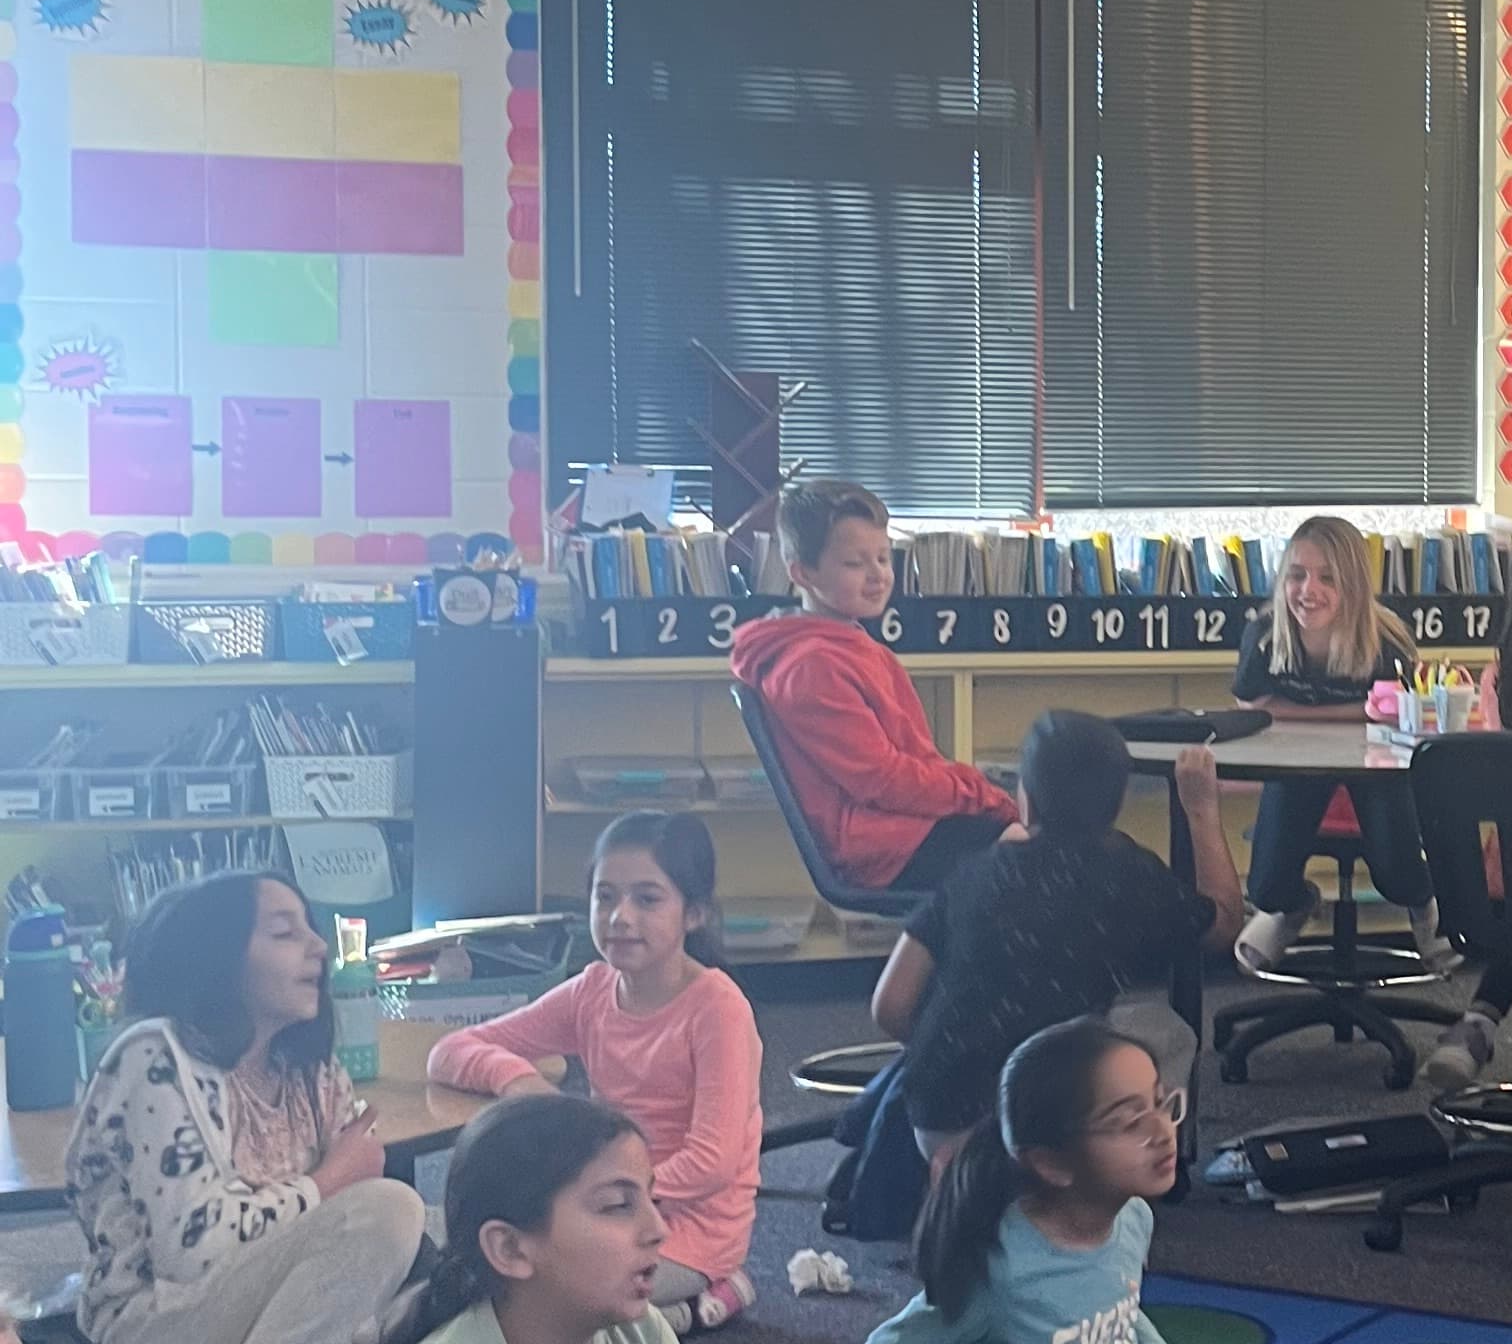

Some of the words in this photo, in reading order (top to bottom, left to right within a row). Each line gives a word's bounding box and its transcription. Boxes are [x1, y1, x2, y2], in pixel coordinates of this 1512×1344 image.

[600, 605, 620, 655] 1
[658, 606, 679, 645] 2
[708, 602, 737, 650] 3
[881, 608, 905, 643] 6
[936, 610, 957, 646] 7
[993, 607, 1013, 645] 8
[1047, 602, 1068, 639] 9
[1091, 607, 1126, 644] 10
[1139, 603, 1171, 650] 11
[1194, 607, 1227, 643] 12
[1412, 606, 1445, 641] 16
[1462, 605, 1492, 639] 17
